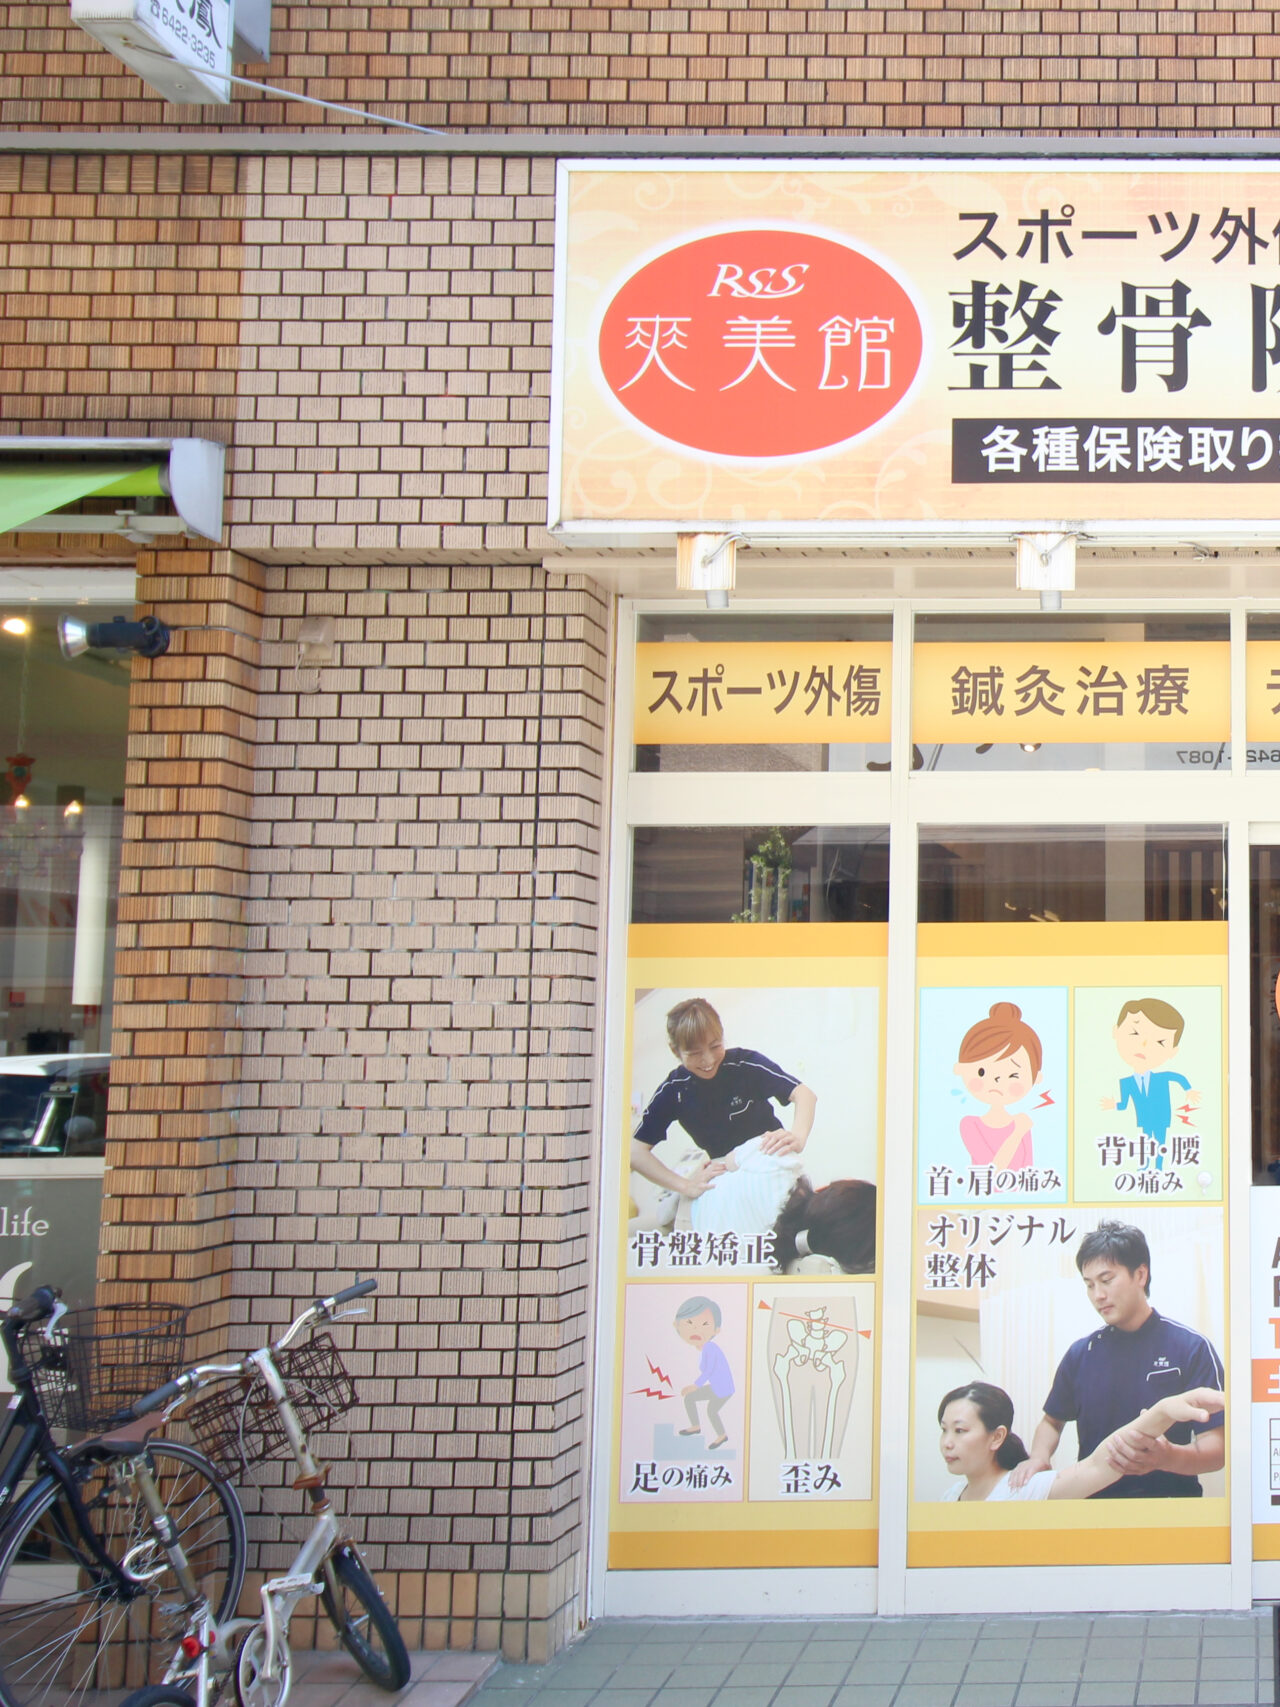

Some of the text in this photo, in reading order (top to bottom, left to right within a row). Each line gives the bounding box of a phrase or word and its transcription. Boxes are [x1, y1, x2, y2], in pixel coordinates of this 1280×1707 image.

[708, 262, 809, 299] RSS
[647, 663, 882, 717] スポーツ外傷
[950, 663, 1191, 717] 鍼灸治療
[1097, 1135, 1200, 1167] 背中・腰
[925, 1165, 1063, 1198] 首・肩の痛み
[1114, 1171, 1184, 1194] の痛み
[0, 1206, 49, 1237] life
[926, 1214, 1078, 1248] オリジナル
[631, 1230, 778, 1268] 骨盤矯正
[925, 1253, 998, 1290] 整体
[630, 1461, 734, 1494] 足の痛み
[780, 1463, 842, 1495] 歪み
